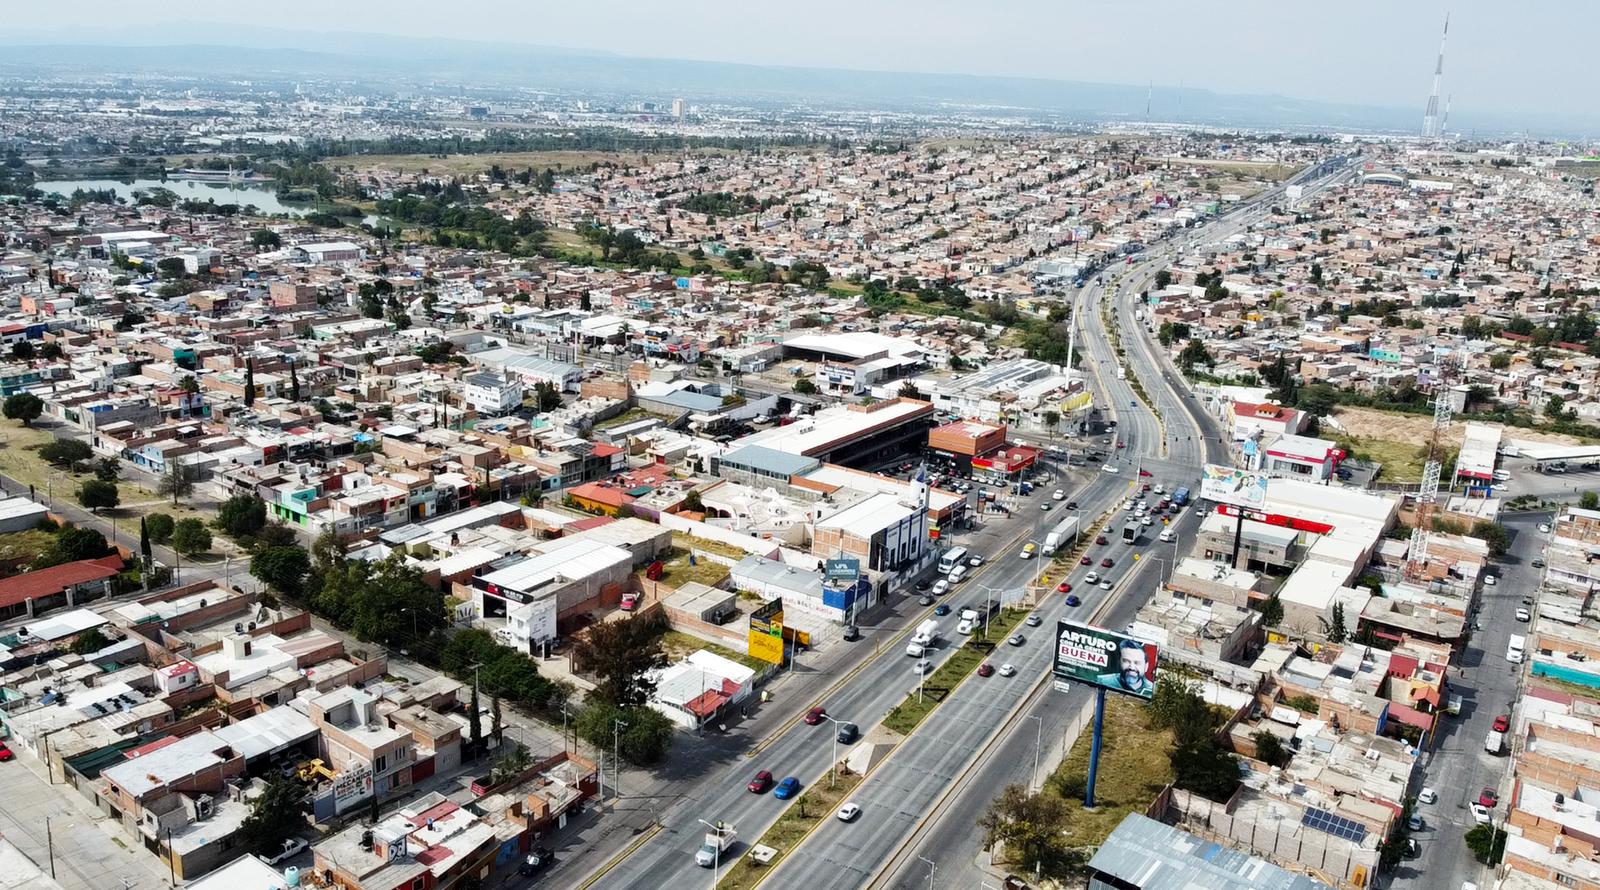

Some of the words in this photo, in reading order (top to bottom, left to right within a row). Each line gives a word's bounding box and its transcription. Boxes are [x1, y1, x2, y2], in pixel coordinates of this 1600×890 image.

[1060, 629, 1117, 651] ARTURO
[1060, 639, 1074, 647] CON
[1084, 645, 1106, 655] GENTE
[1061, 646, 1105, 665] BUENA
[336, 770, 372, 791] MECANICO
[343, 768, 365, 781] TALLER
